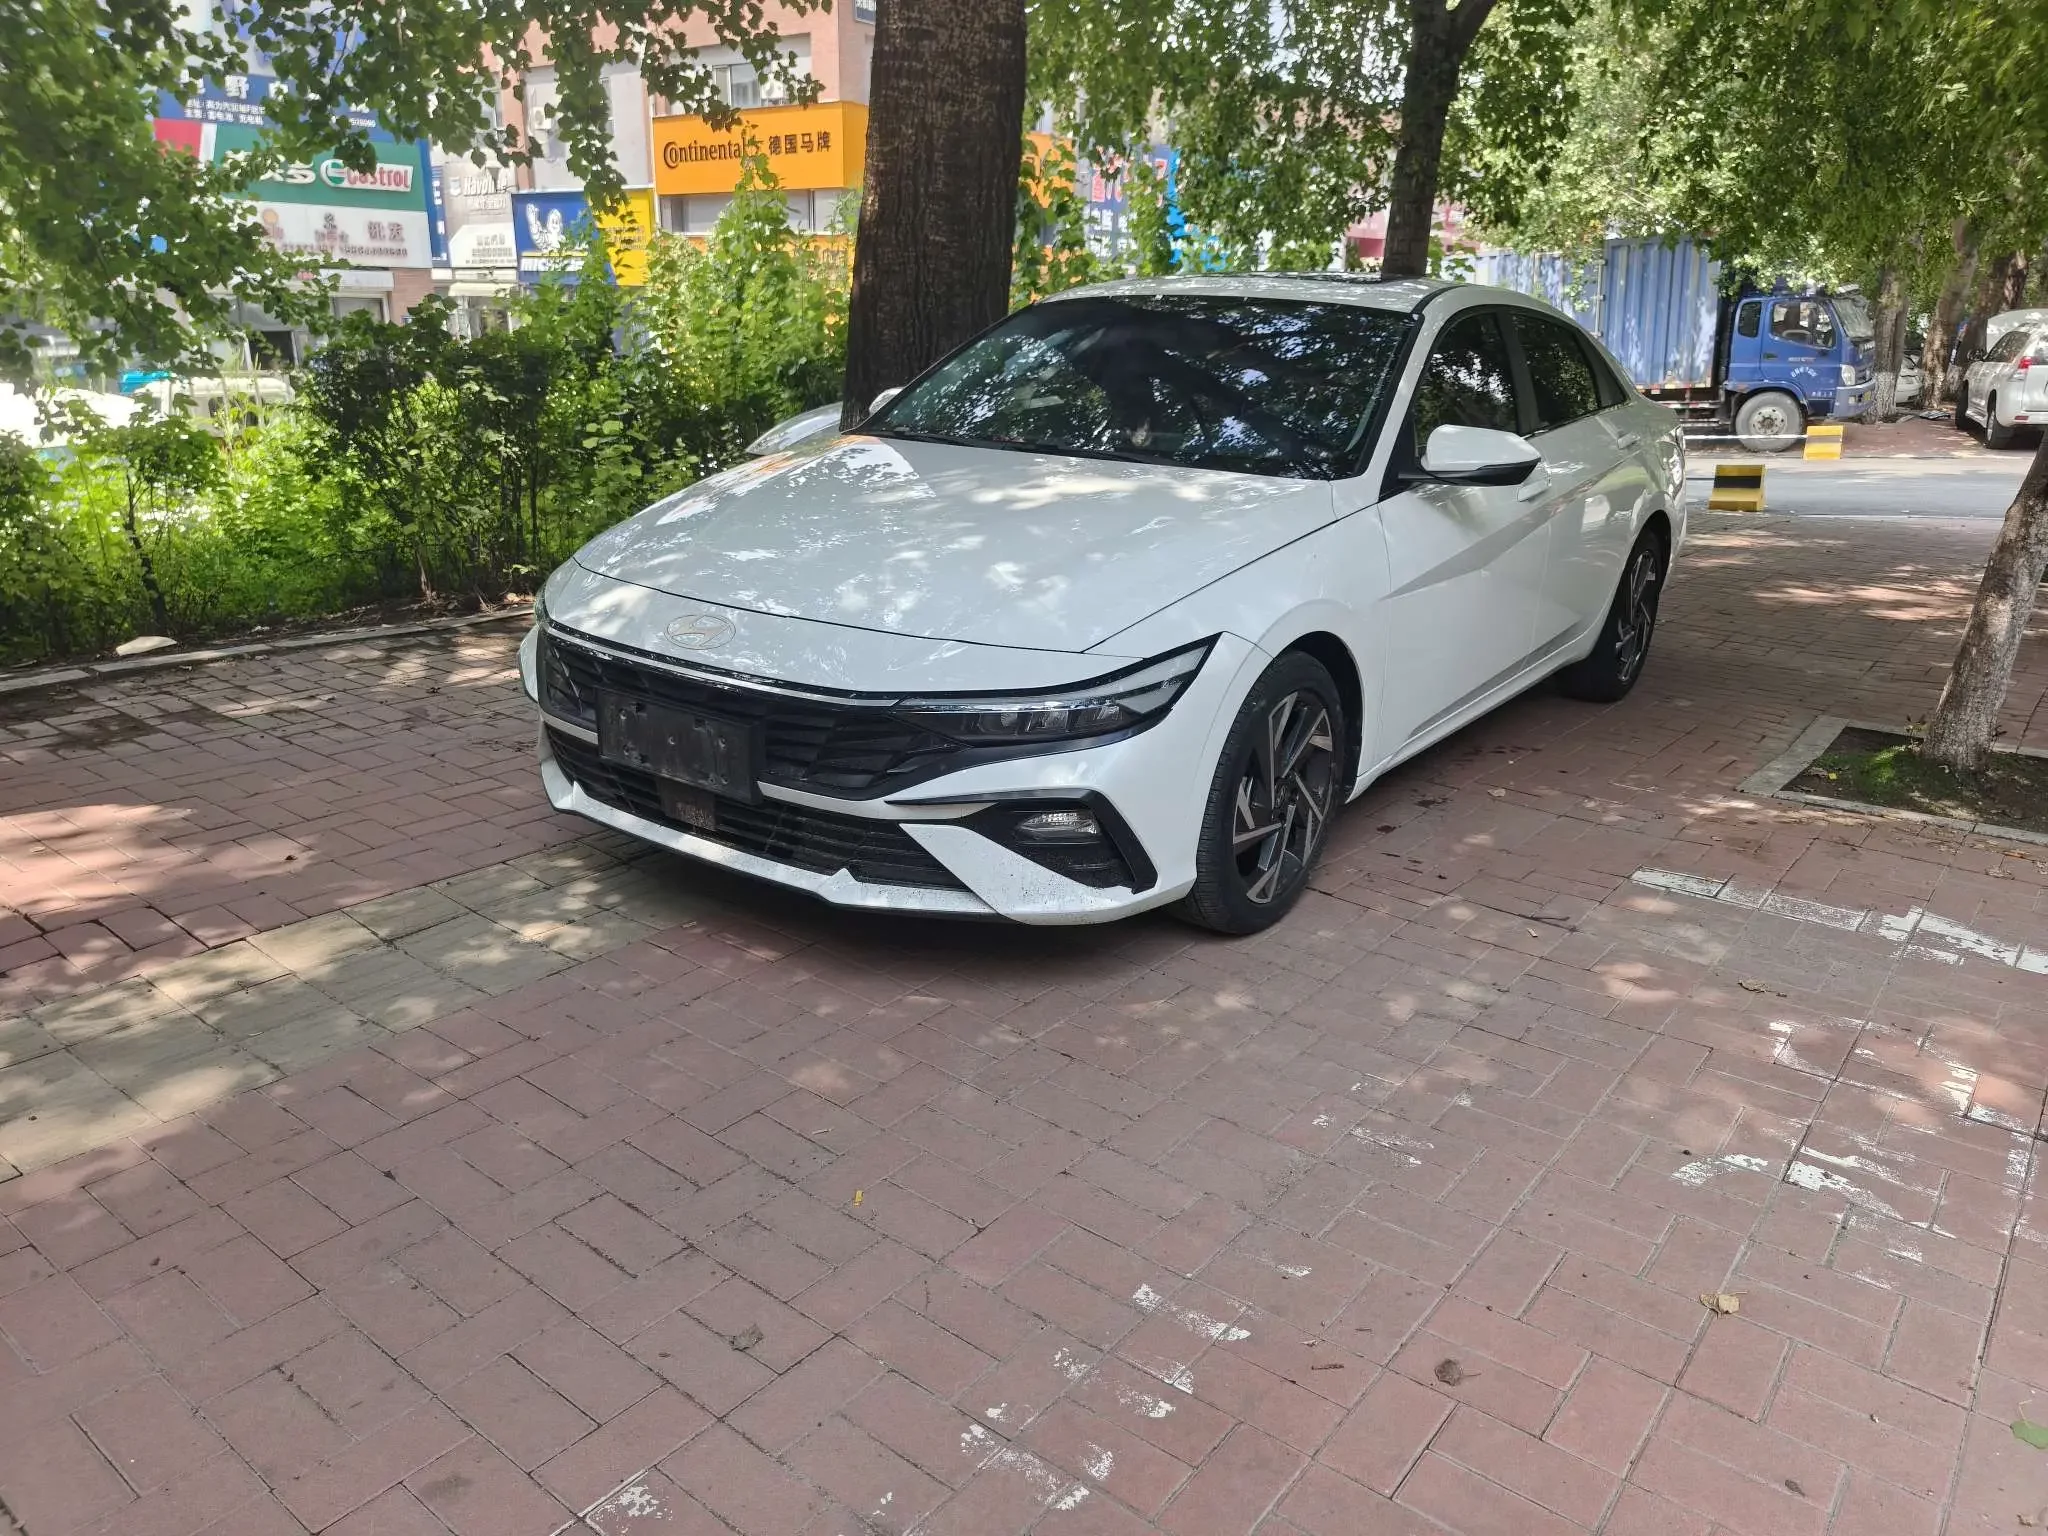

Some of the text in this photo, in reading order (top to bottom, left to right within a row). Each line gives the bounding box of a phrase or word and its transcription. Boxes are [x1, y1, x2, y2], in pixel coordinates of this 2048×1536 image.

[664, 131, 832, 169] Continental 德国马牌
